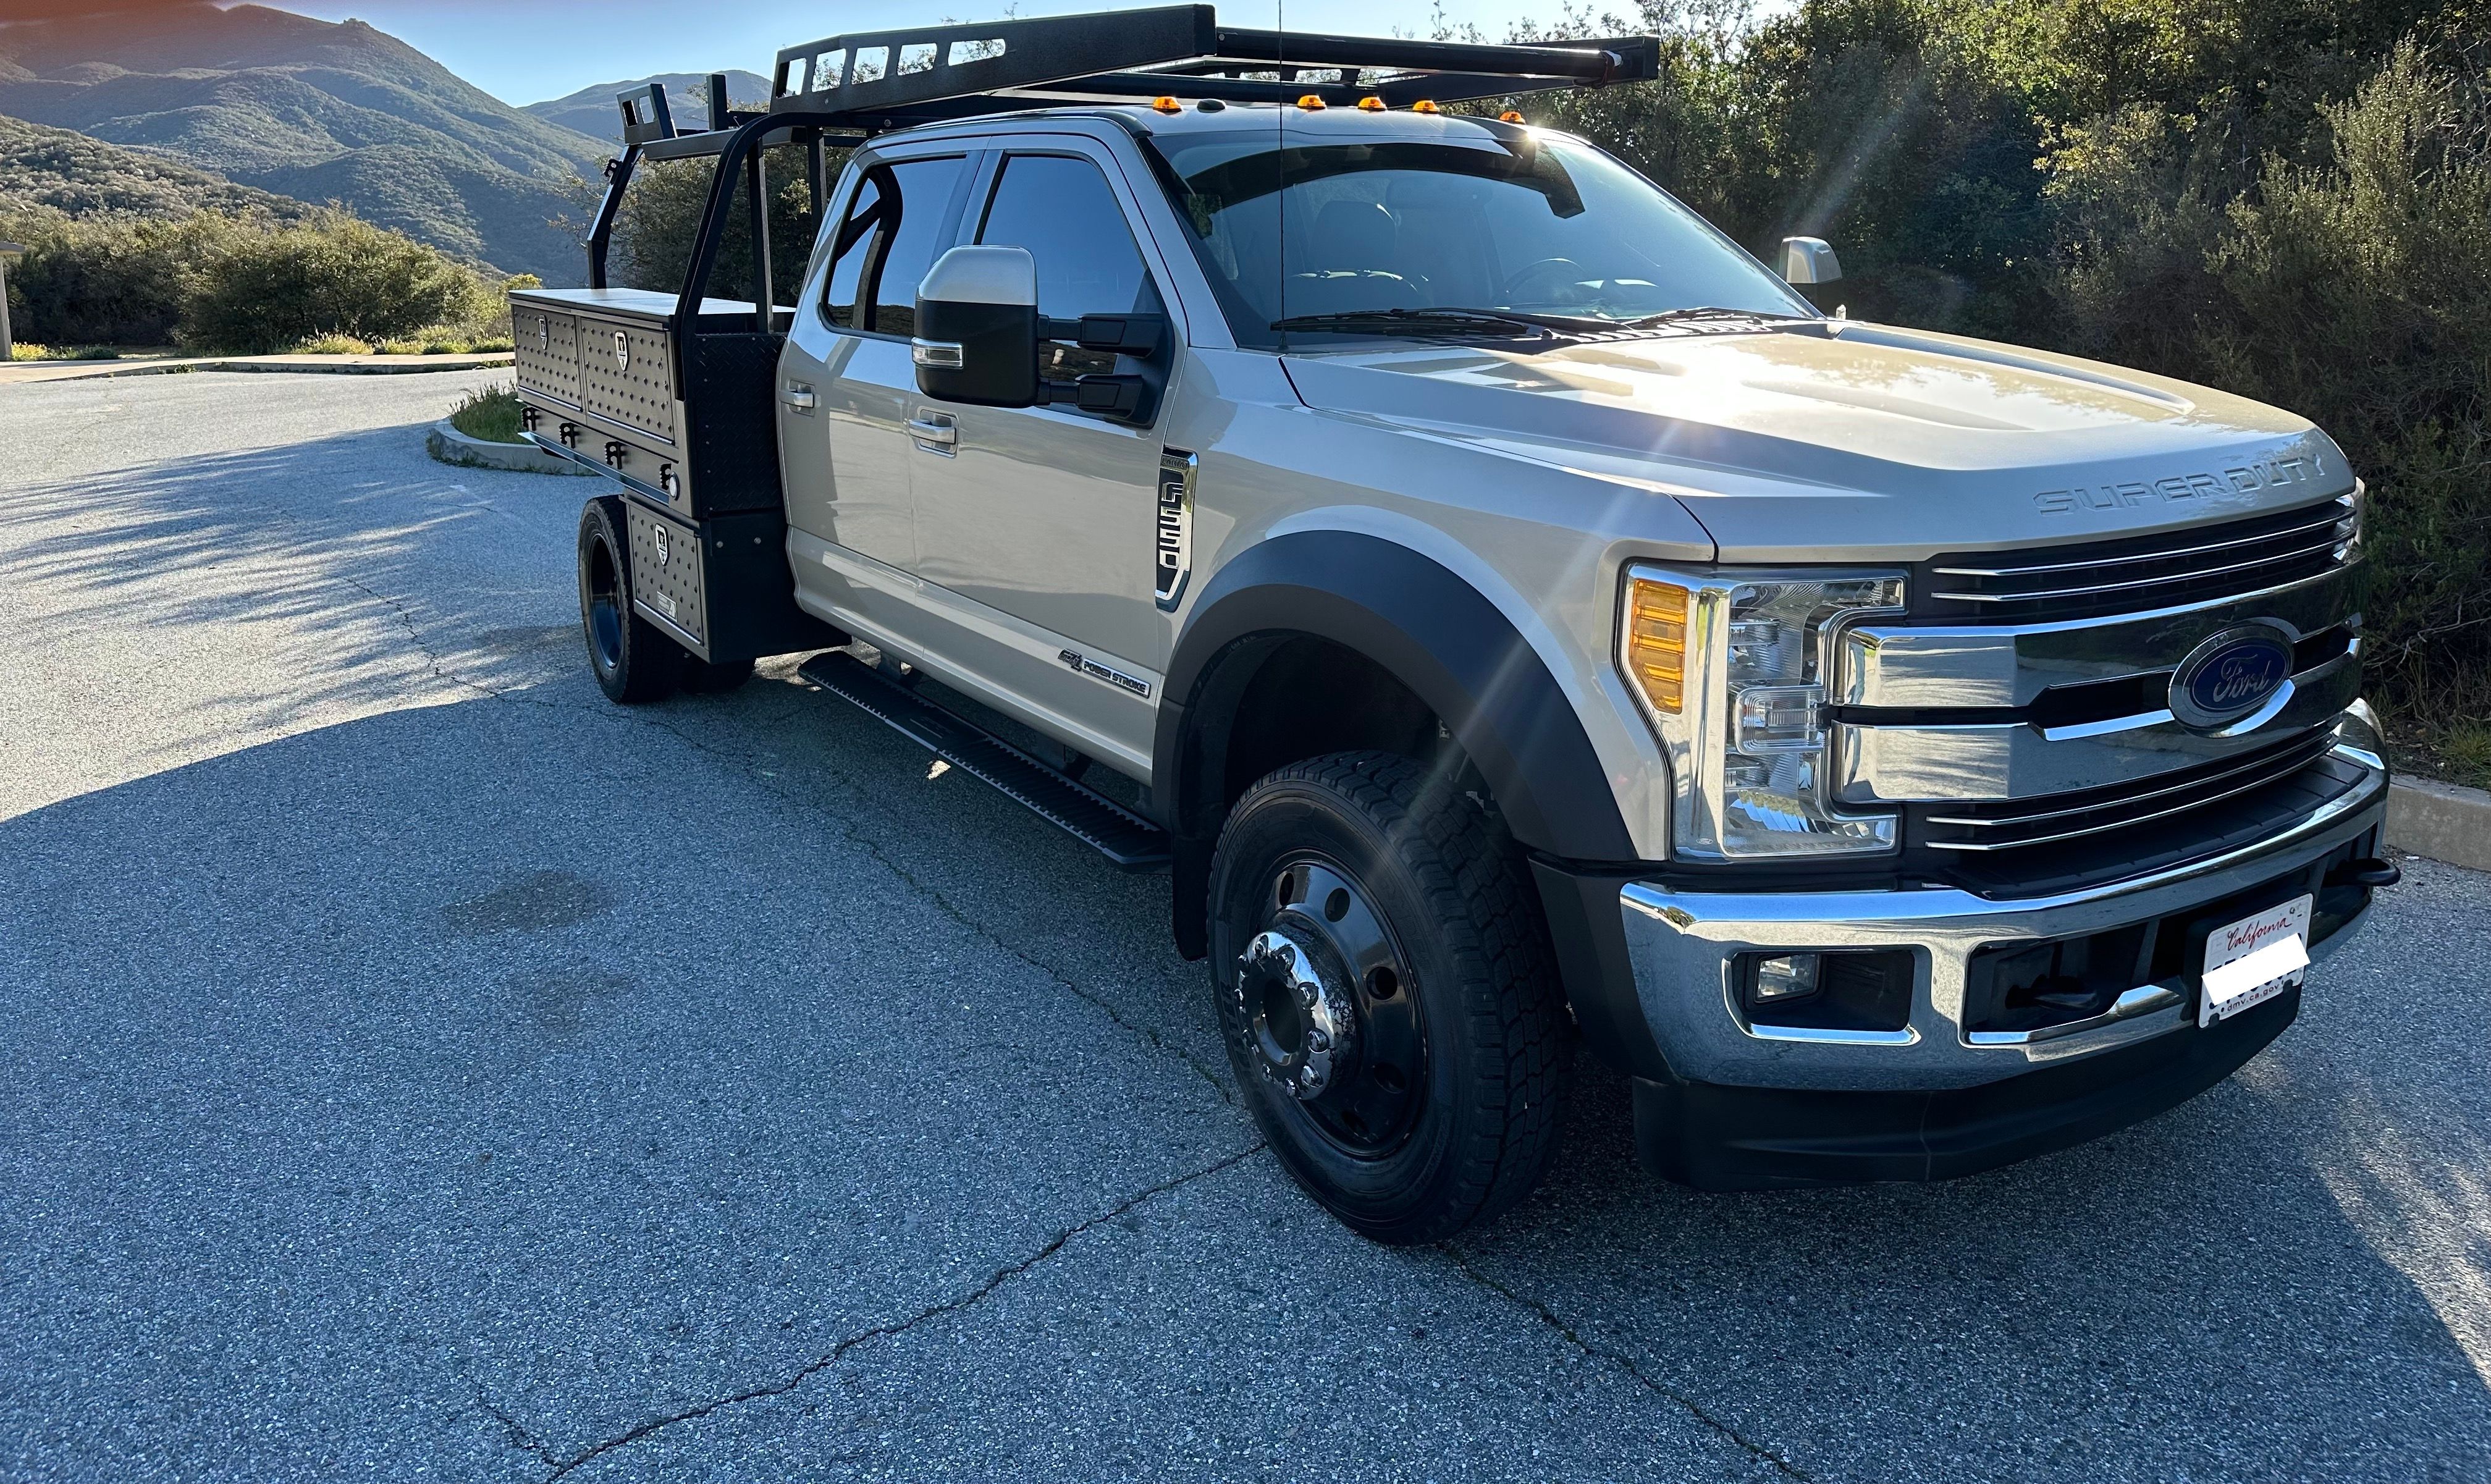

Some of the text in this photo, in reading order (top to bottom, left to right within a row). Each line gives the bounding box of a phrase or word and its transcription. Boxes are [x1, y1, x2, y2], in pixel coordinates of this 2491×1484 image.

[2033, 455, 2325, 515] SUPER DUTY
[1084, 660, 1146, 693] POWER STROKE
[2213, 654, 2272, 702] Ford
[2227, 917, 2292, 951] California
[2227, 984, 2279, 1011] dmv.ca.gov
